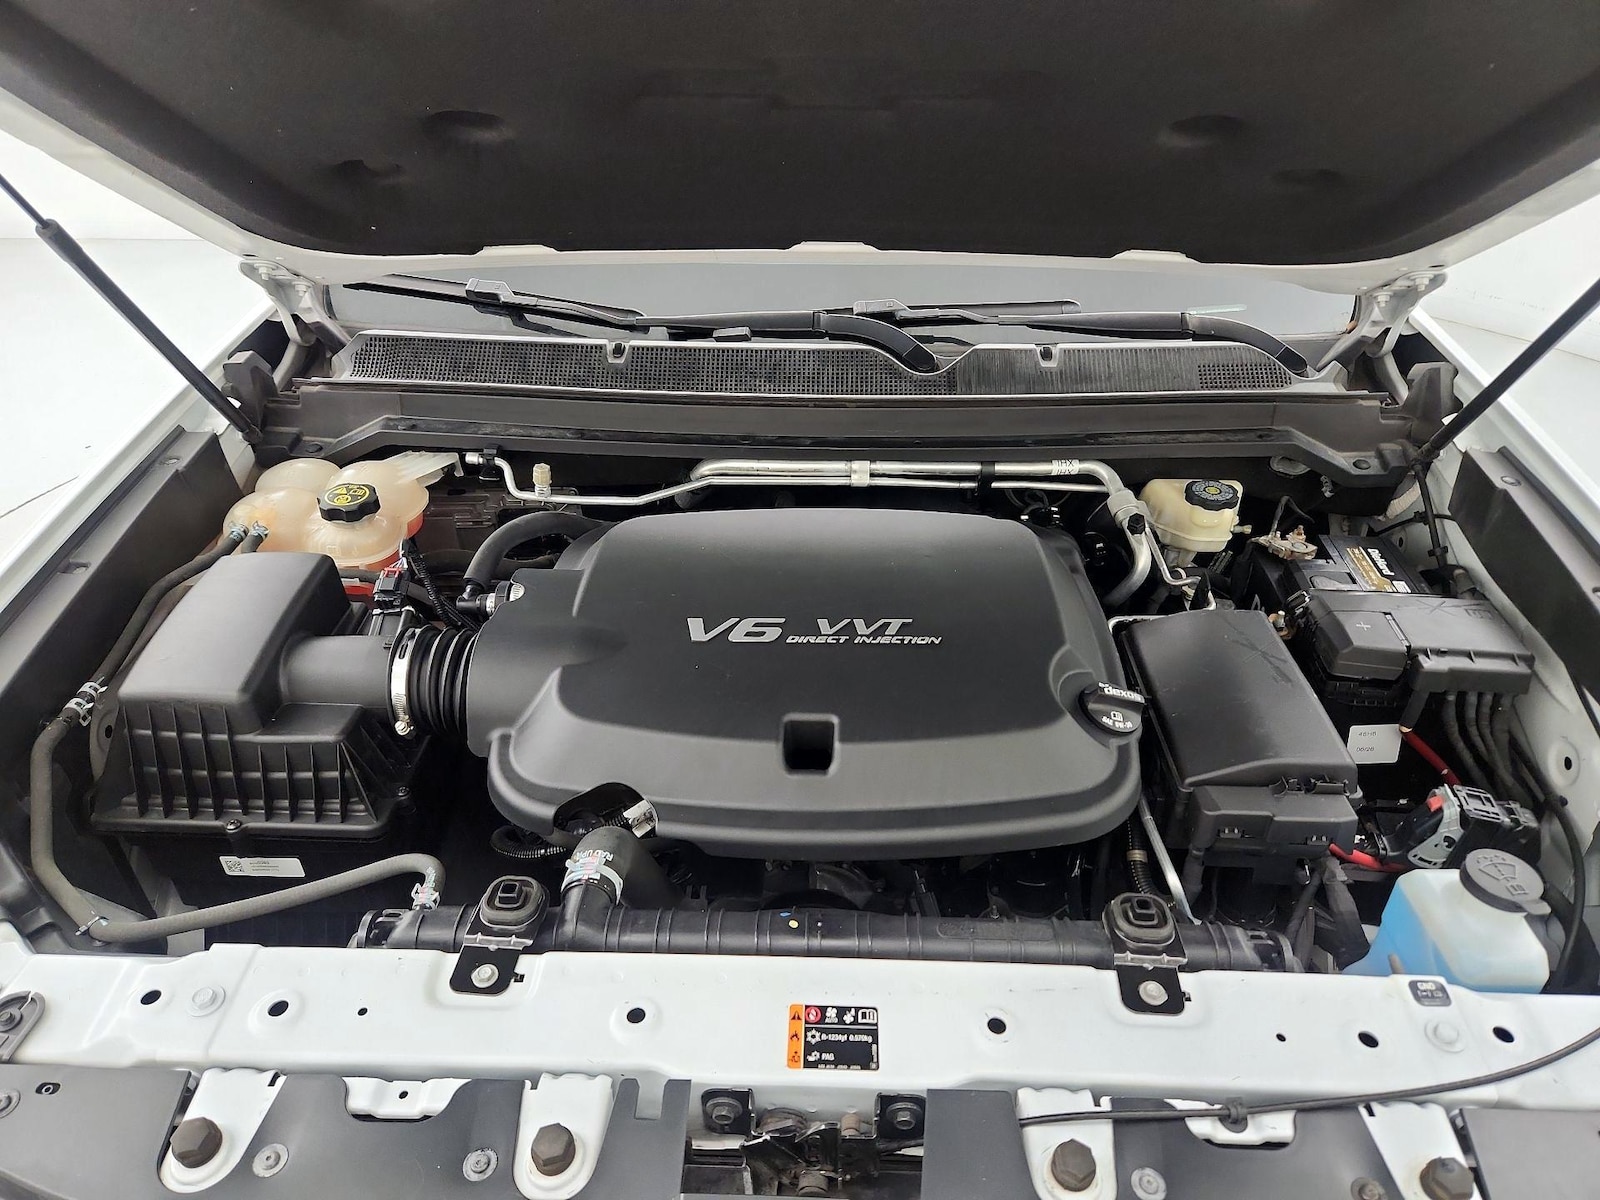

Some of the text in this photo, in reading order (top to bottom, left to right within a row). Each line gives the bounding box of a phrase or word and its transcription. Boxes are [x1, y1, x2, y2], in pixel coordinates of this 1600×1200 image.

[1367, 548, 1395, 576] DieHard
[687, 617, 913, 642] V6 VVT
[785, 634, 942, 645] DIRECT INJECTION
